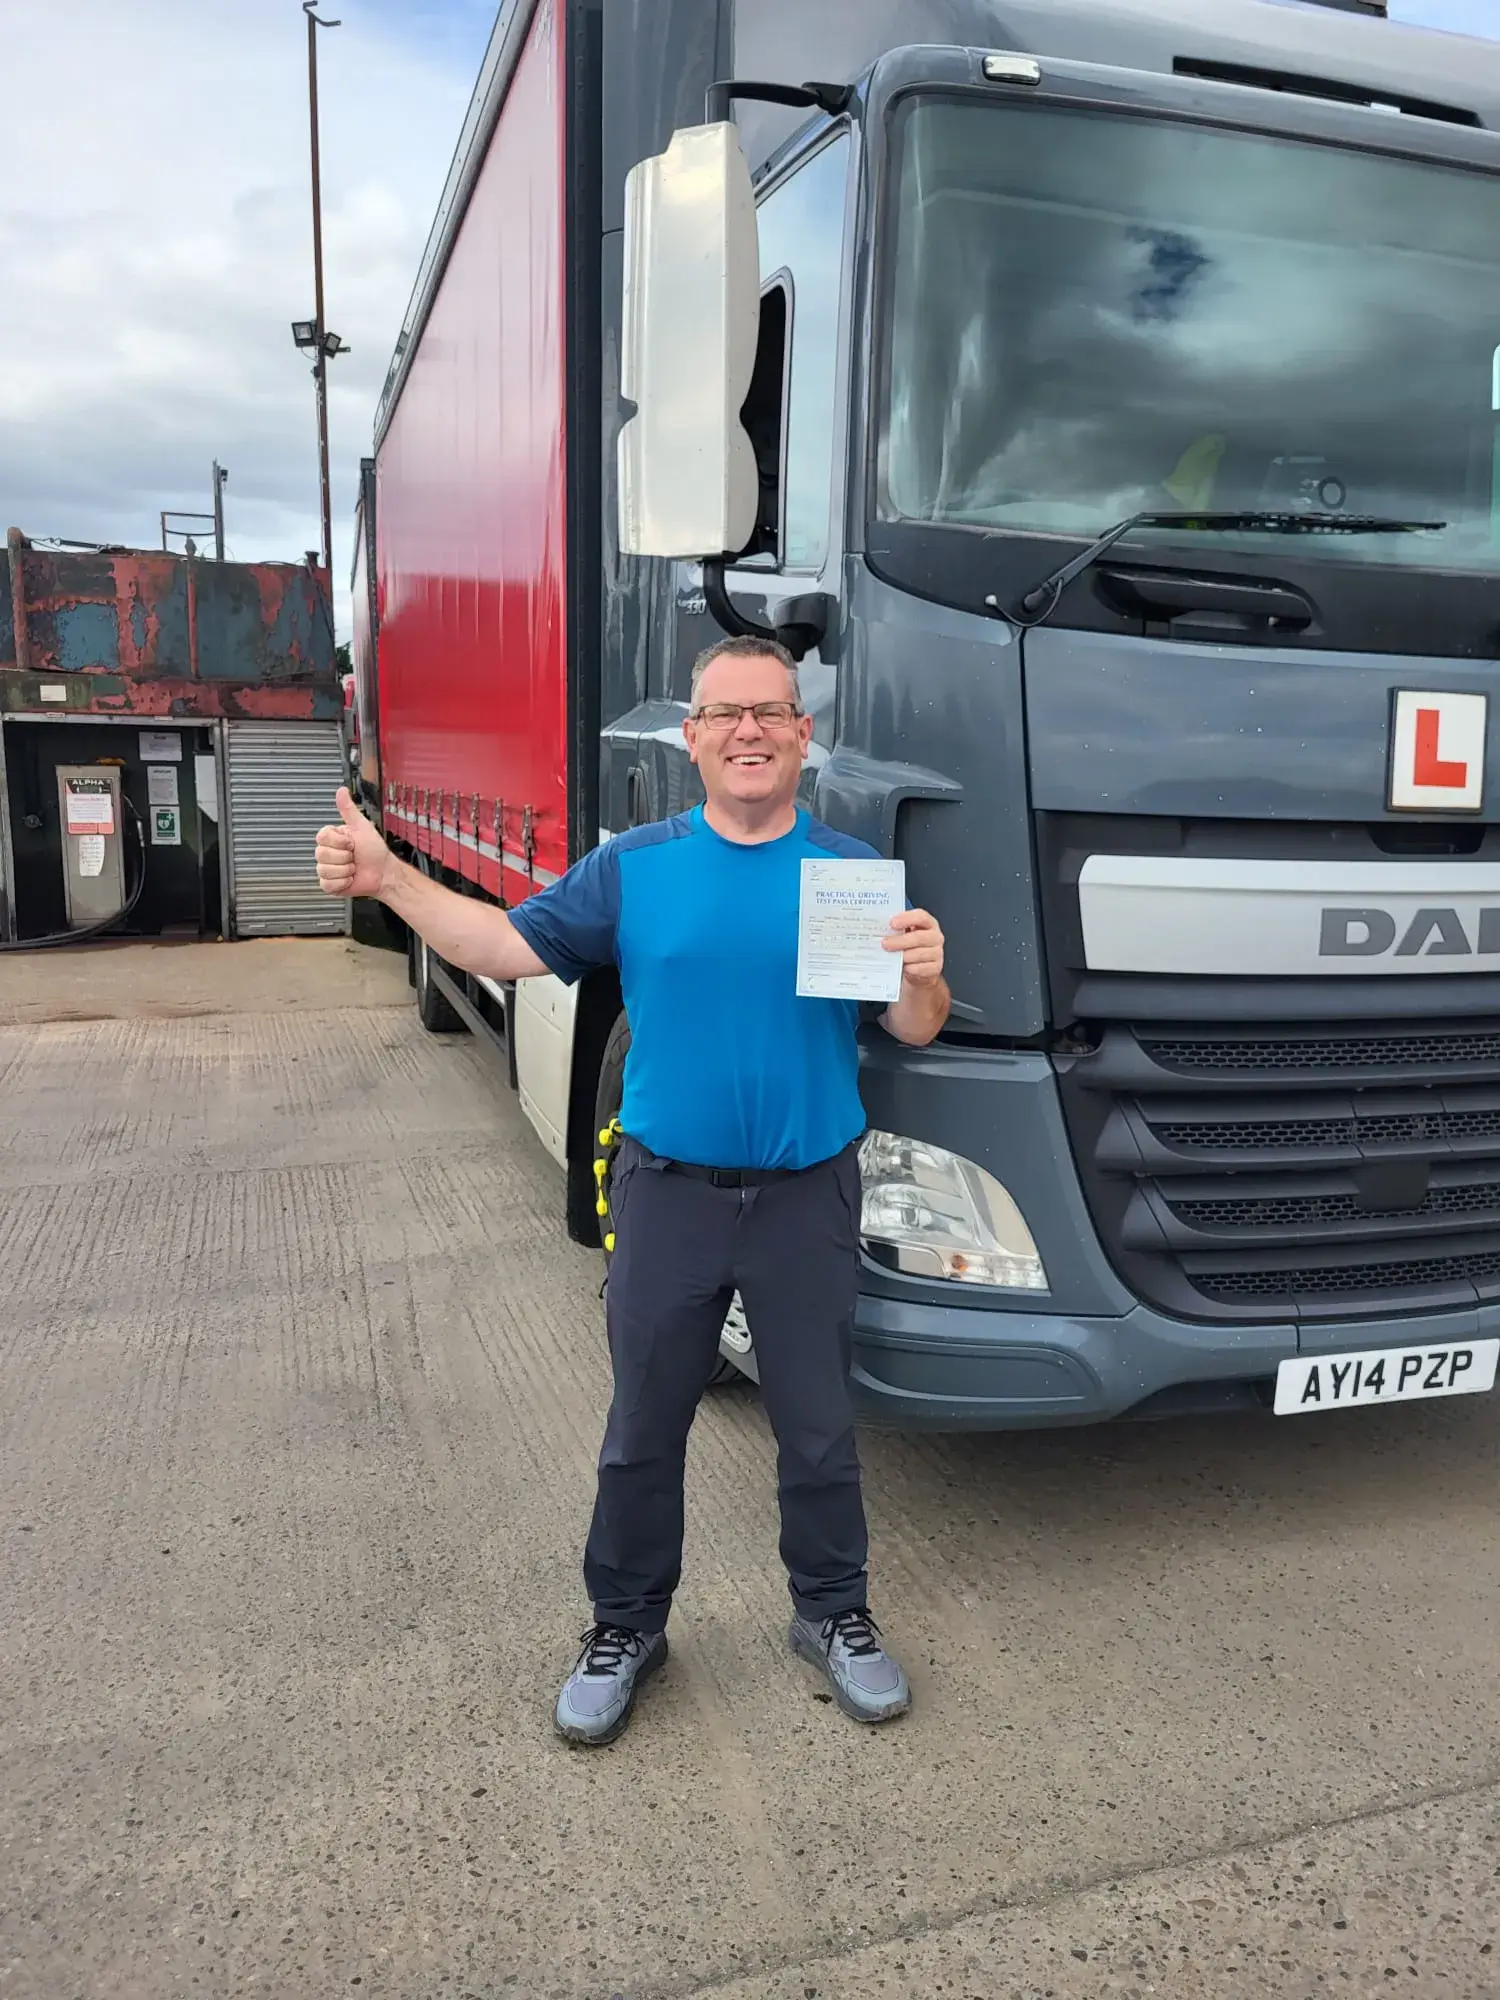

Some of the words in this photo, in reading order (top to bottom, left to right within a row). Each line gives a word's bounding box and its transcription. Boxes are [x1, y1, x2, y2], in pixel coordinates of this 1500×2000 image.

[1412, 708, 1468, 788] L
[72, 778, 104, 786] ALPHA
[815, 891, 855, 899] PRACTICAL
[857, 891, 890, 899] DRIVING
[849, 898, 890, 906] CERTIFICATE
[1300, 1358, 1386, 1404] AY14
[1397, 1349, 1474, 1393] PZP
